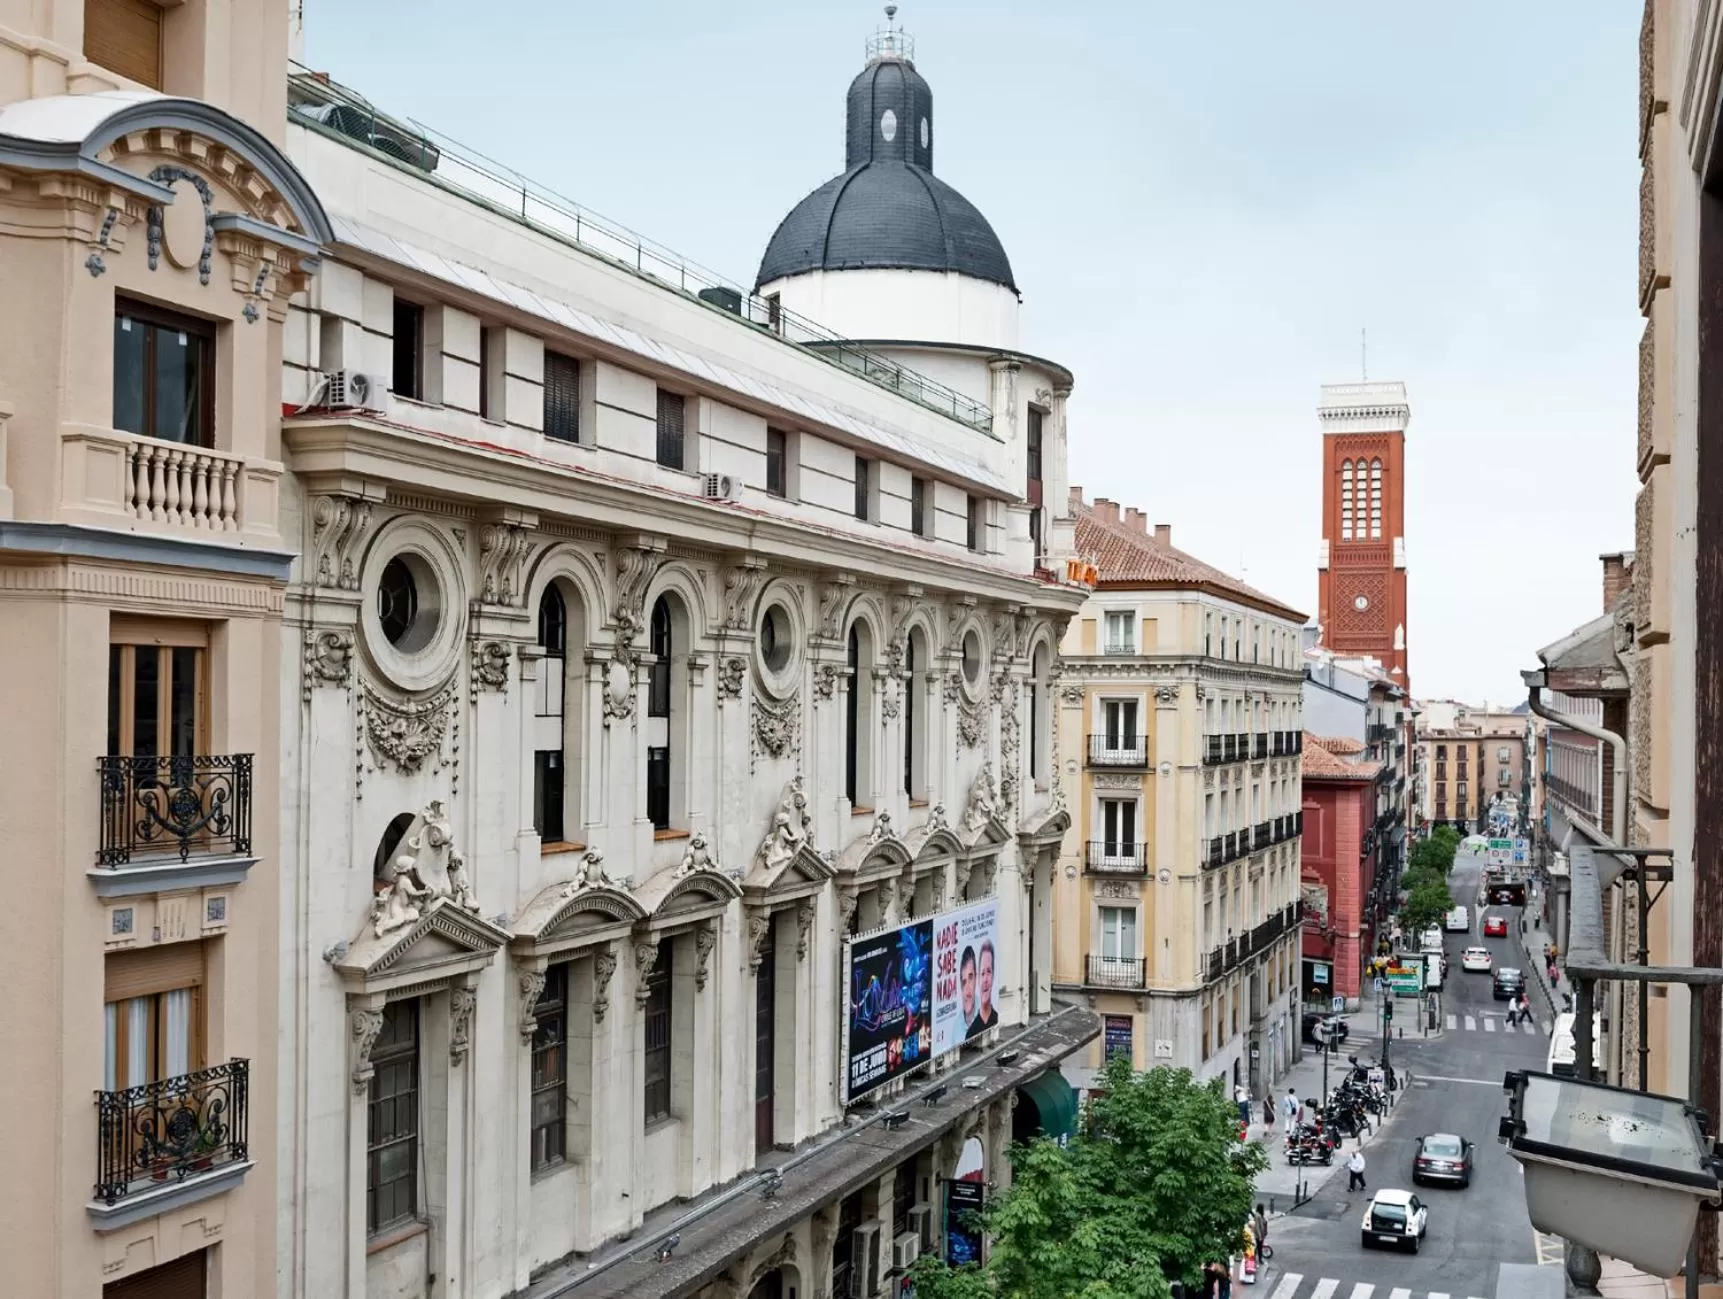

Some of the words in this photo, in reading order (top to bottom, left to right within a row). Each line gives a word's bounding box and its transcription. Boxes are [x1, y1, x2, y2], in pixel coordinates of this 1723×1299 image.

[937, 921, 958, 949] NADIE
[937, 948, 957, 978] SABE
[937, 975, 957, 1002] NADA
